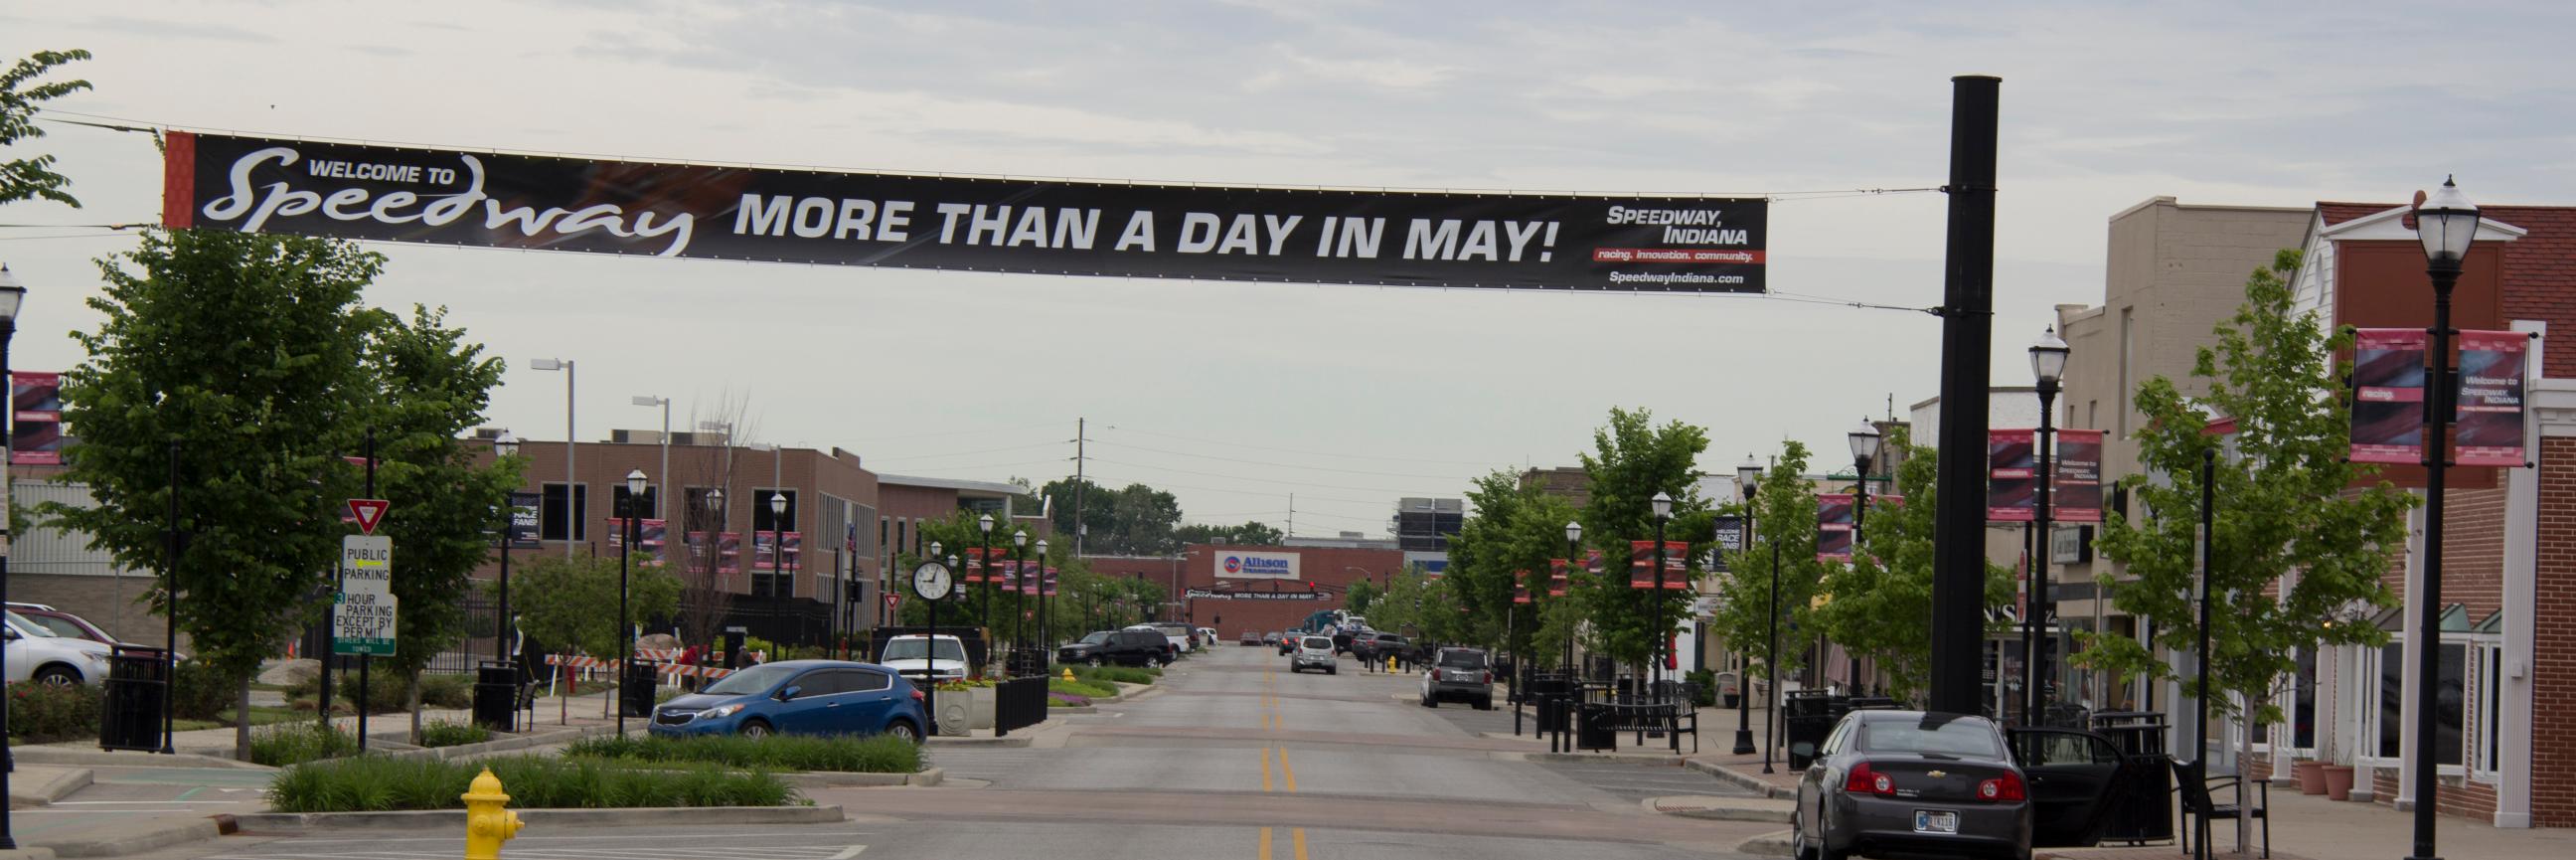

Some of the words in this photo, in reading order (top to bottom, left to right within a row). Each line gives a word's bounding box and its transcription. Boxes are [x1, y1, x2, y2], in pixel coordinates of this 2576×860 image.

[309, 159, 419, 183] WELCOME
[427, 166, 455, 185] TO
[203, 147, 694, 257] Speedway
[1606, 206, 1721, 227] SPEEDWAY,
[733, 194, 914, 242] MORE
[937, 203, 1100, 250] THAN
[1114, 210, 1156, 252] A
[1177, 212, 1303, 257] DAY
[1317, 216, 1385, 258] IN
[1402, 218, 1559, 262] MAY!
[1663, 226, 1748, 245] INDIANA
[1598, 250, 1633, 262] racing.
[1636, 250, 1691, 260] innovation.
[1694, 251, 1754, 263] community.
[1609, 271, 1743, 284] SpeedwayIndiana.com
[2466, 376, 2505, 385] Welcome
[348, 549, 387, 561] PUBLIC
[1243, 557, 1288, 568] Allison
[344, 568, 389, 581] PARKING
[337, 594, 344, 603] 3
[348, 595, 375, 604] HOUR
[347, 605, 392, 616] PARKING
[336, 615, 374, 626] EXCEPT
[380, 617, 392, 627] BY
[344, 627, 382, 637] PERMIT
